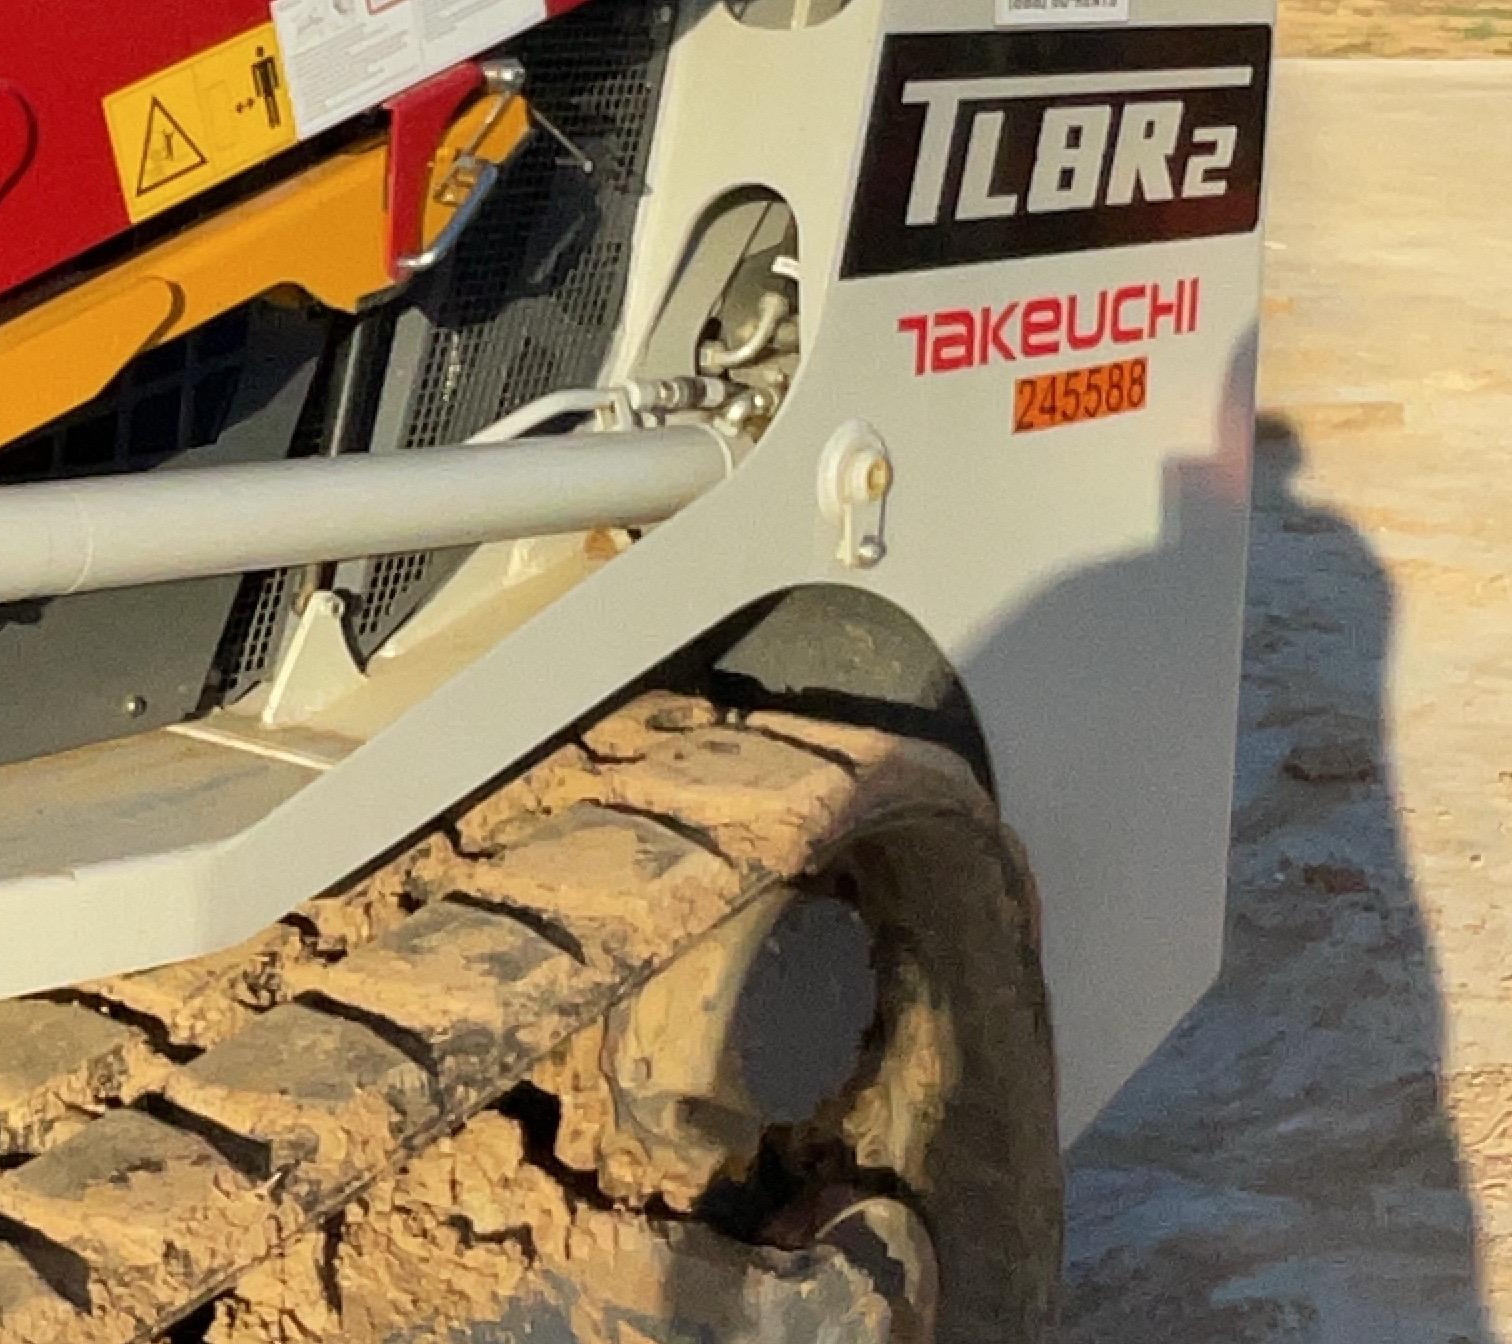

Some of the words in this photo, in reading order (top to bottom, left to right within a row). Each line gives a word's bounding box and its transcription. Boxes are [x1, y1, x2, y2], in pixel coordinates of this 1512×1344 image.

[901, 65, 1254, 226] TL8R2
[897, 276, 1200, 377] TAKEUCHI
[1014, 357, 1147, 431] 245588
